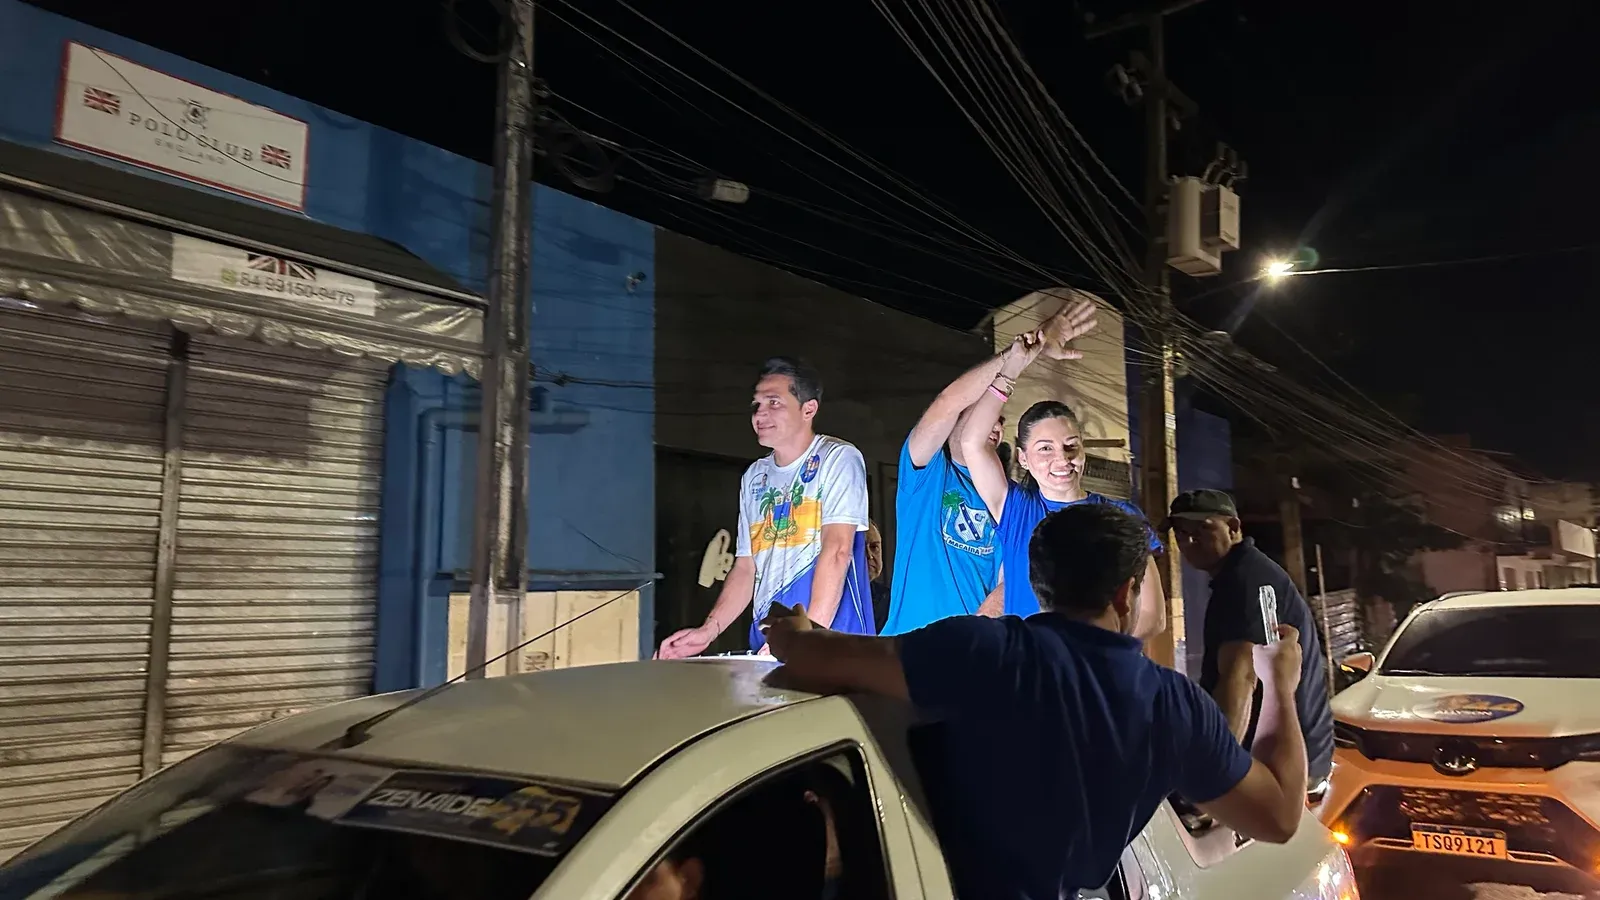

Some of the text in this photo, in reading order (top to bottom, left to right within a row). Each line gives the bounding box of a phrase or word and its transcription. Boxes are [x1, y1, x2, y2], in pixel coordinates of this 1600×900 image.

[127, 112, 254, 162] POLO CLUB
[240, 271, 260, 287] 84
[368, 788, 491, 817] ZENAIDE
